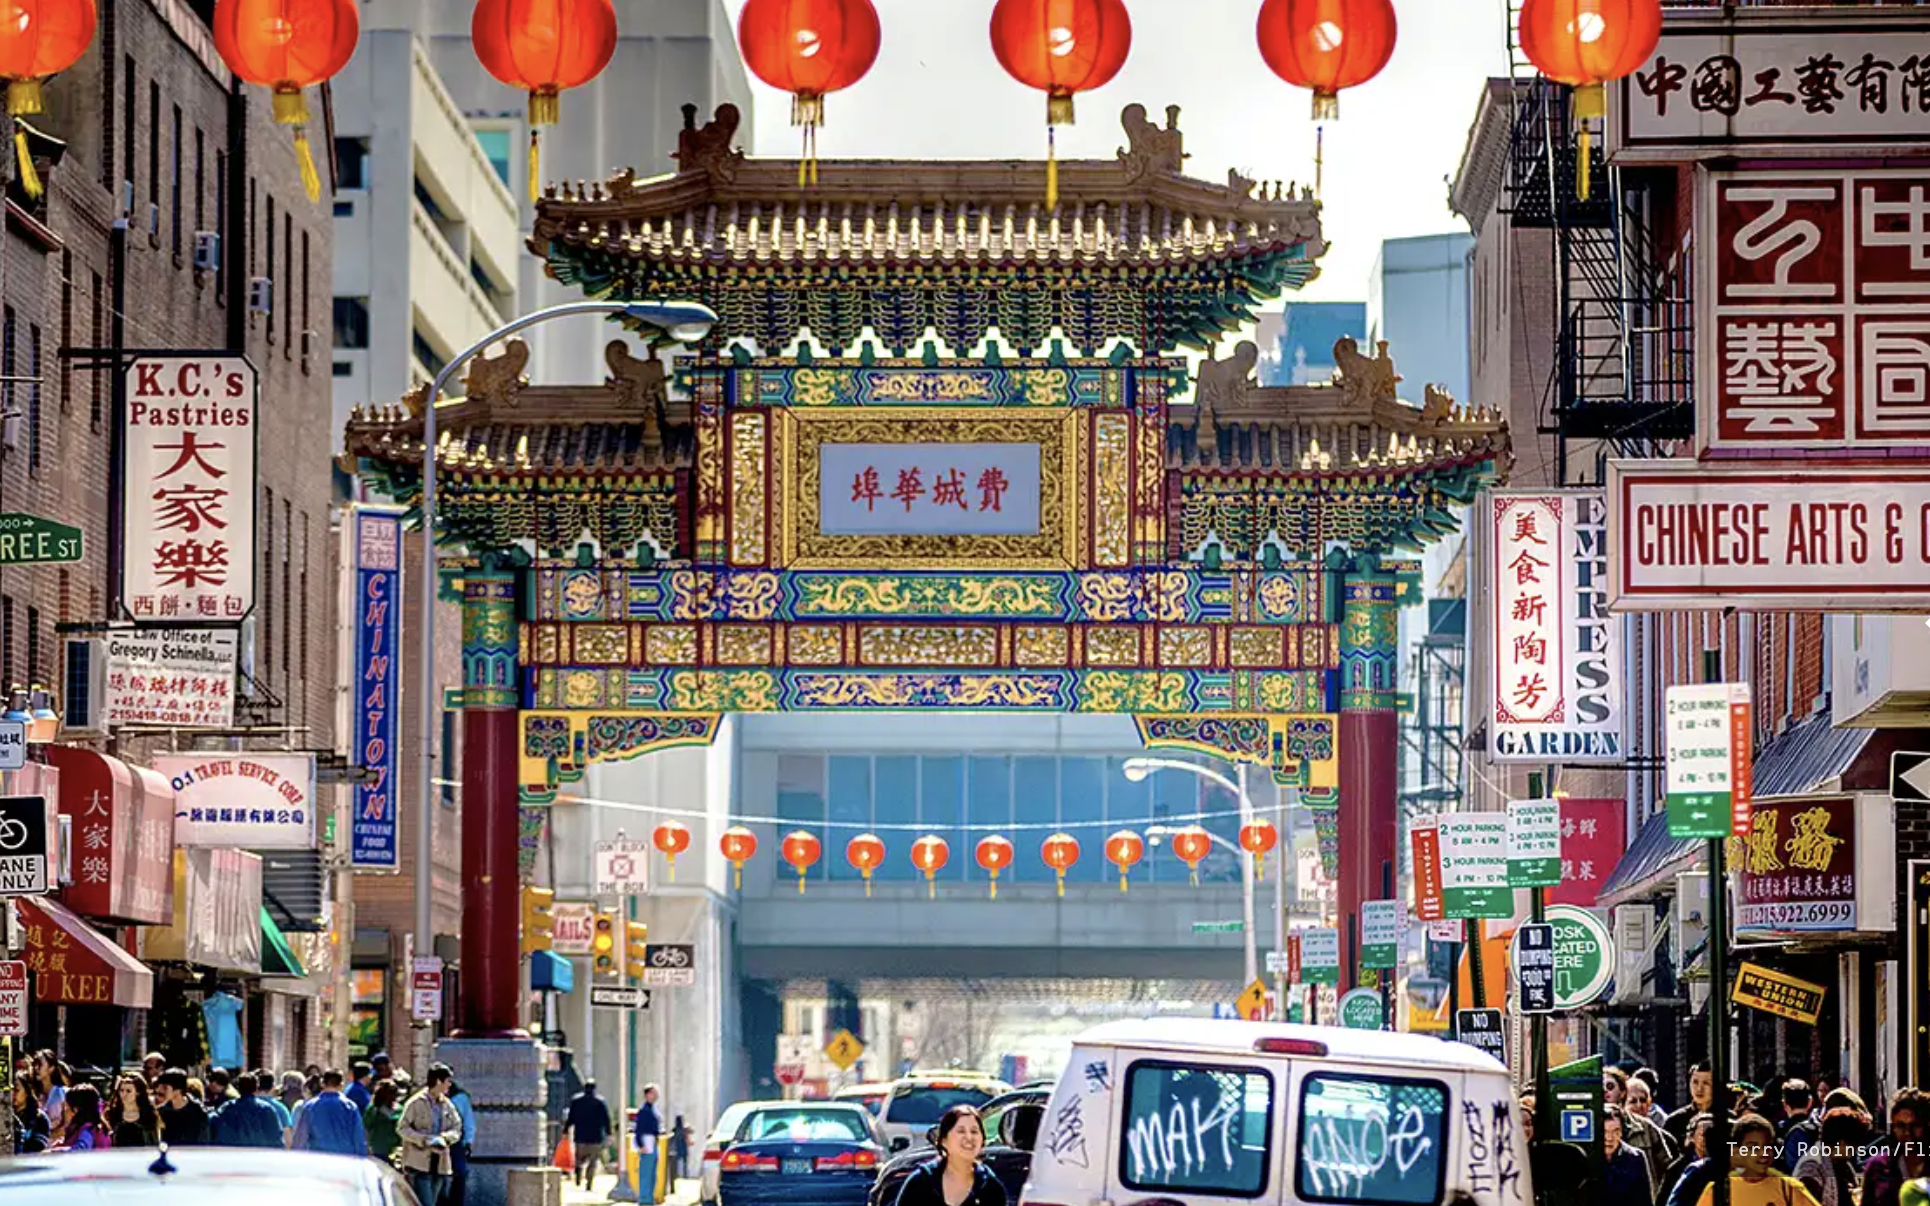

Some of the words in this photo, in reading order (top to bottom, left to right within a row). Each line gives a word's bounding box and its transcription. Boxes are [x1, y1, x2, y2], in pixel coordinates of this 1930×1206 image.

[135, 362, 243, 397] K.C.'s
[130, 402, 249, 426] Pastries
[152, 431, 228, 588] 大家樂
[1637, 503, 1769, 566] CHINESE
[1786, 502, 1868, 565] ARTS
[1886, 503, 1902, 563] &
[58, 538, 77, 558] ST
[1507, 510, 1550, 710] 美食新陶芳
[1574, 496, 1611, 725] EMPRESS
[162, 630, 197, 643] Office
[200, 631, 213, 643] of
[110, 641, 157, 661] Gregory
[361, 572, 389, 820] CHINATOWN
[1678, 701, 1696, 711] HOUR
[1699, 700, 1727, 710] PARKING
[1496, 731, 1620, 756] GARDEN
[194, 760, 233, 782] TRAVEL
[238, 761, 279, 786] SERVICE
[82, 789, 109, 884] 大家樂
[1440, 824, 1448, 835] 2
[1451, 824, 1472, 832] HOUR
[1475, 824, 1505, 832] PARKING
[0, 858, 36, 872] ANE
[1443, 858, 1451, 868] 3
[1478, 857, 1507, 865] PARKING
[3, 874, 36, 889] NLY
[1529, 929, 1542, 945] NO
[1553, 926, 1585, 939] OSK
[1553, 941, 1597, 954] CATED
[1555, 955, 1584, 968] ERE
[61, 974, 109, 1001] KEE
[1745, 973, 1807, 999] WESTERN
[1761, 989, 1804, 1008] UNION
[0, 1008, 20, 1019] IME
[1472, 1013, 1488, 1028] NO
[1461, 1031, 1502, 1046] DUMPING
